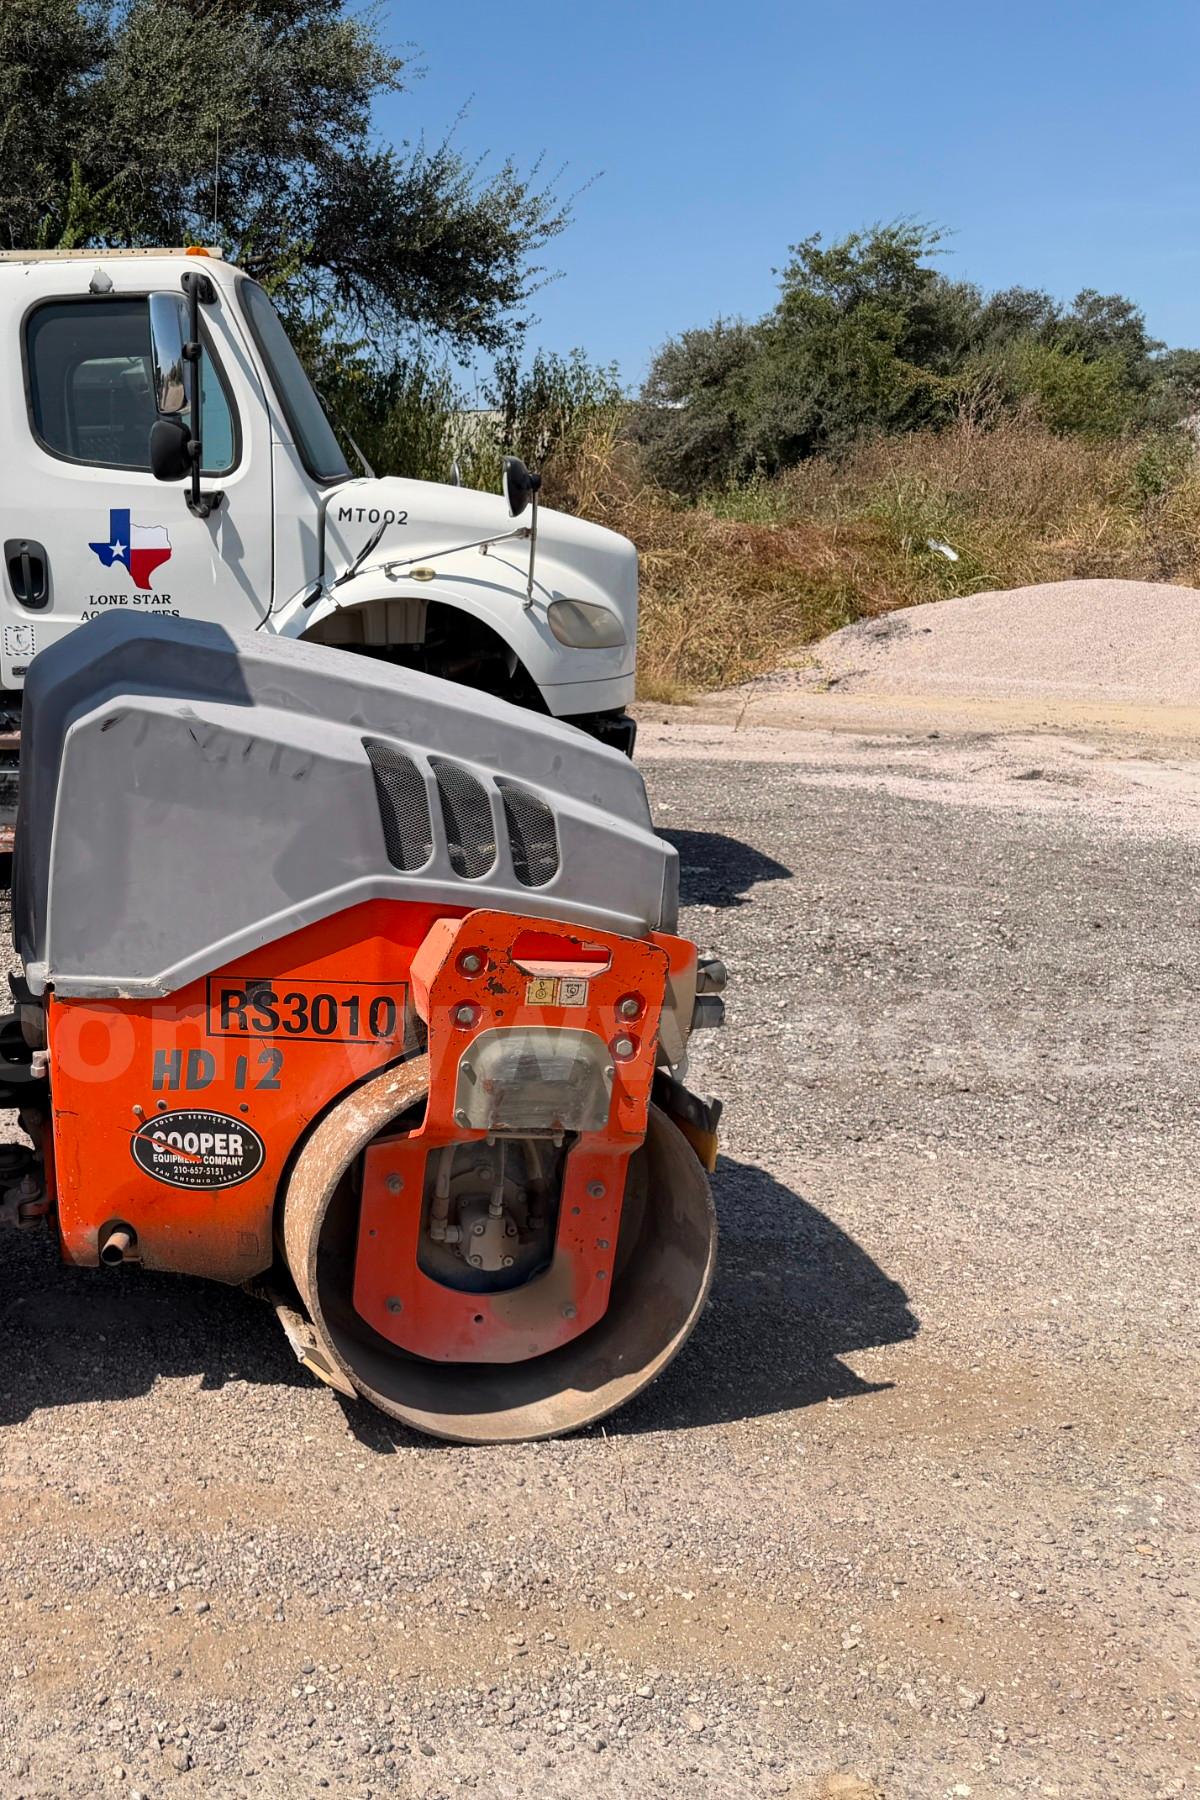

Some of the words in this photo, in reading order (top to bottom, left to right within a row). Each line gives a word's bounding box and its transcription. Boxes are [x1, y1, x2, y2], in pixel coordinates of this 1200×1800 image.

[90, 595, 128, 605] LONE
[133, 594, 172, 604] STAR
[220, 989, 397, 1038] RS3010
[152, 1049, 216, 1091] HD
[154, 1117, 174, 1127] SOLD
[188, 1114, 227, 1123] SERVICED
[152, 1130, 244, 1155] COOPER
[203, 1155, 244, 1166] COMPANY
[155, 1167, 170, 1177] SAN
[218, 1170, 243, 1182] TEXAS
[173, 1165, 224, 1175] 210-657-5151
